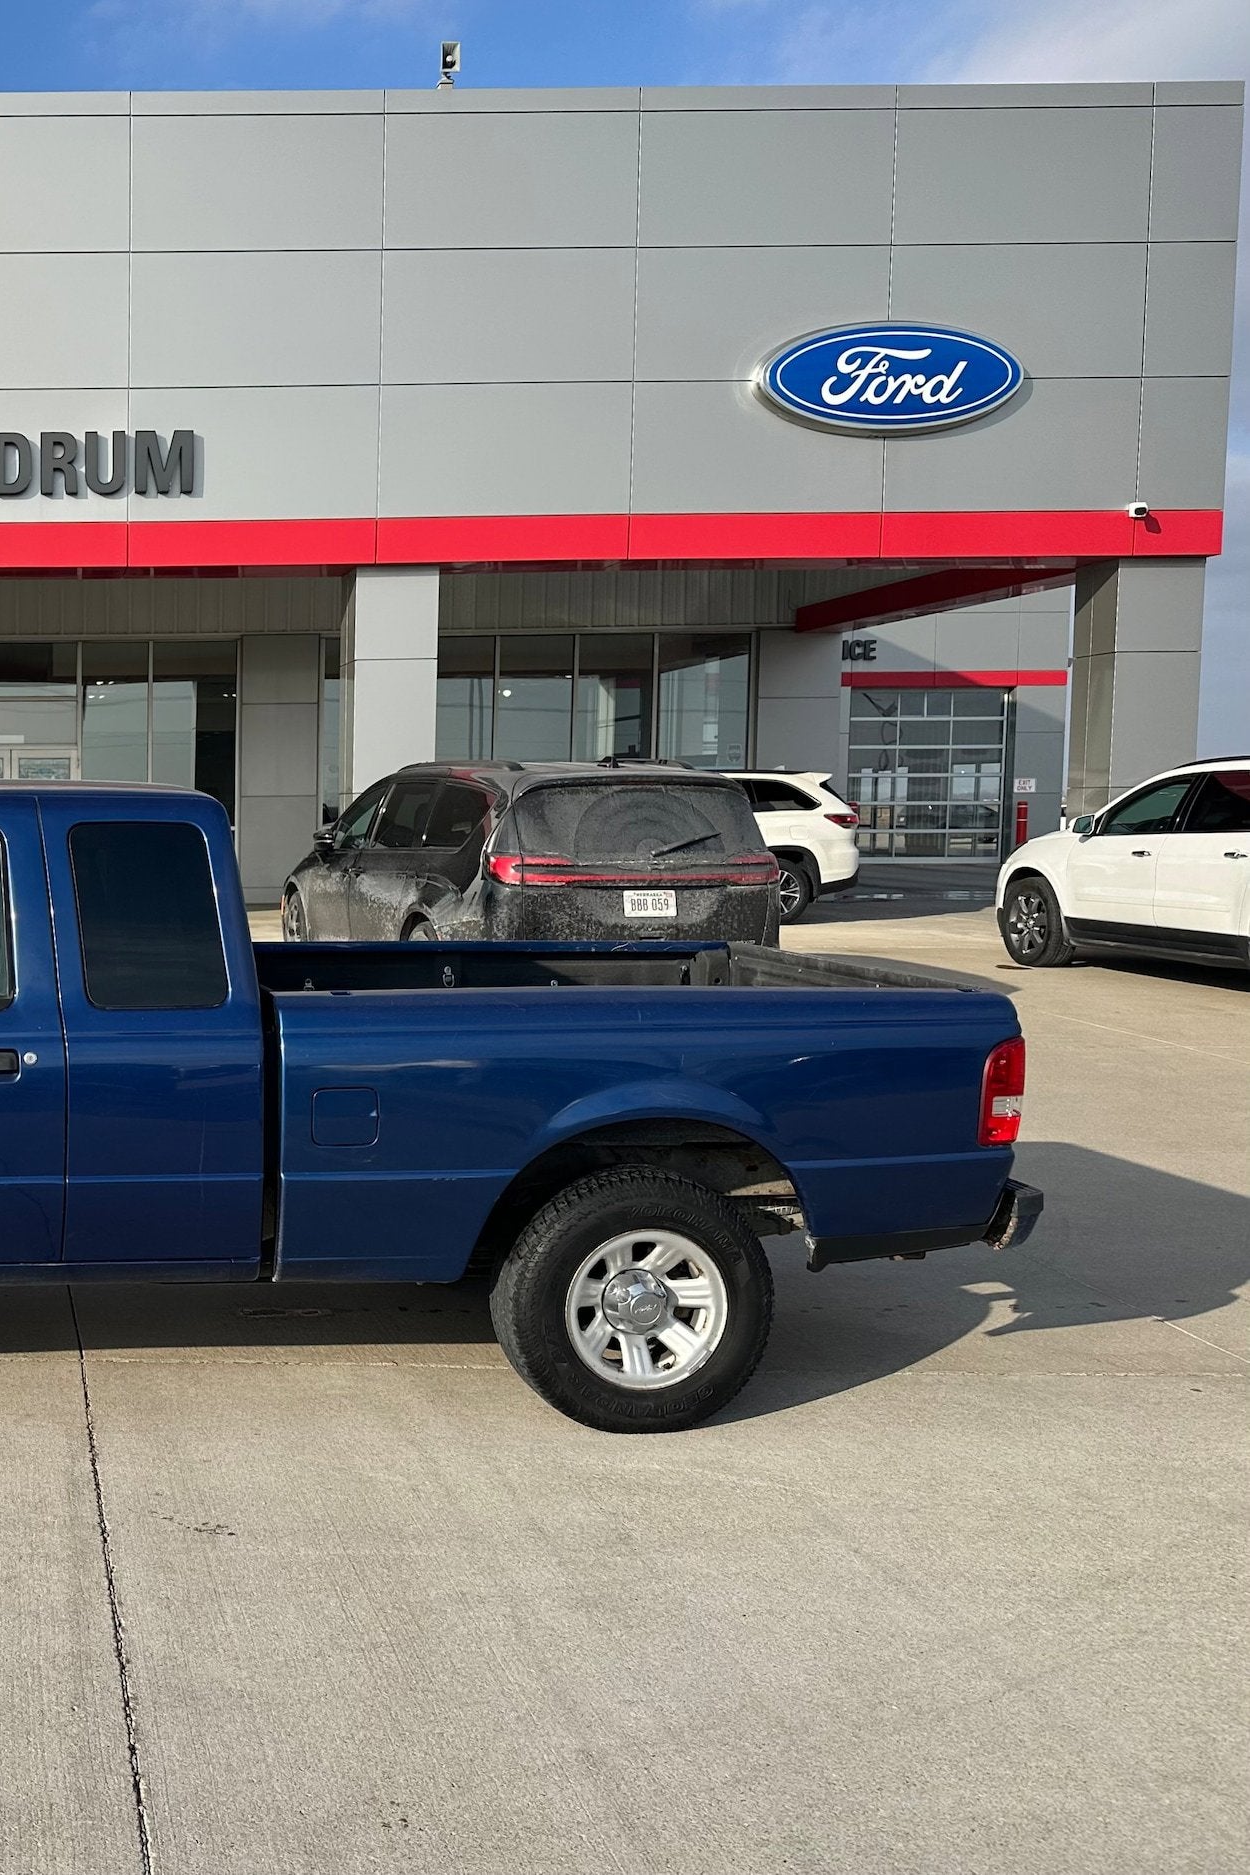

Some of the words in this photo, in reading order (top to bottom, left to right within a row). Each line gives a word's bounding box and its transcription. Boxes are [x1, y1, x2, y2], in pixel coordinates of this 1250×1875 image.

[821, 346, 968, 405] Ford
[631, 898, 649, 911] BBB
[651, 898, 669, 911] 059
